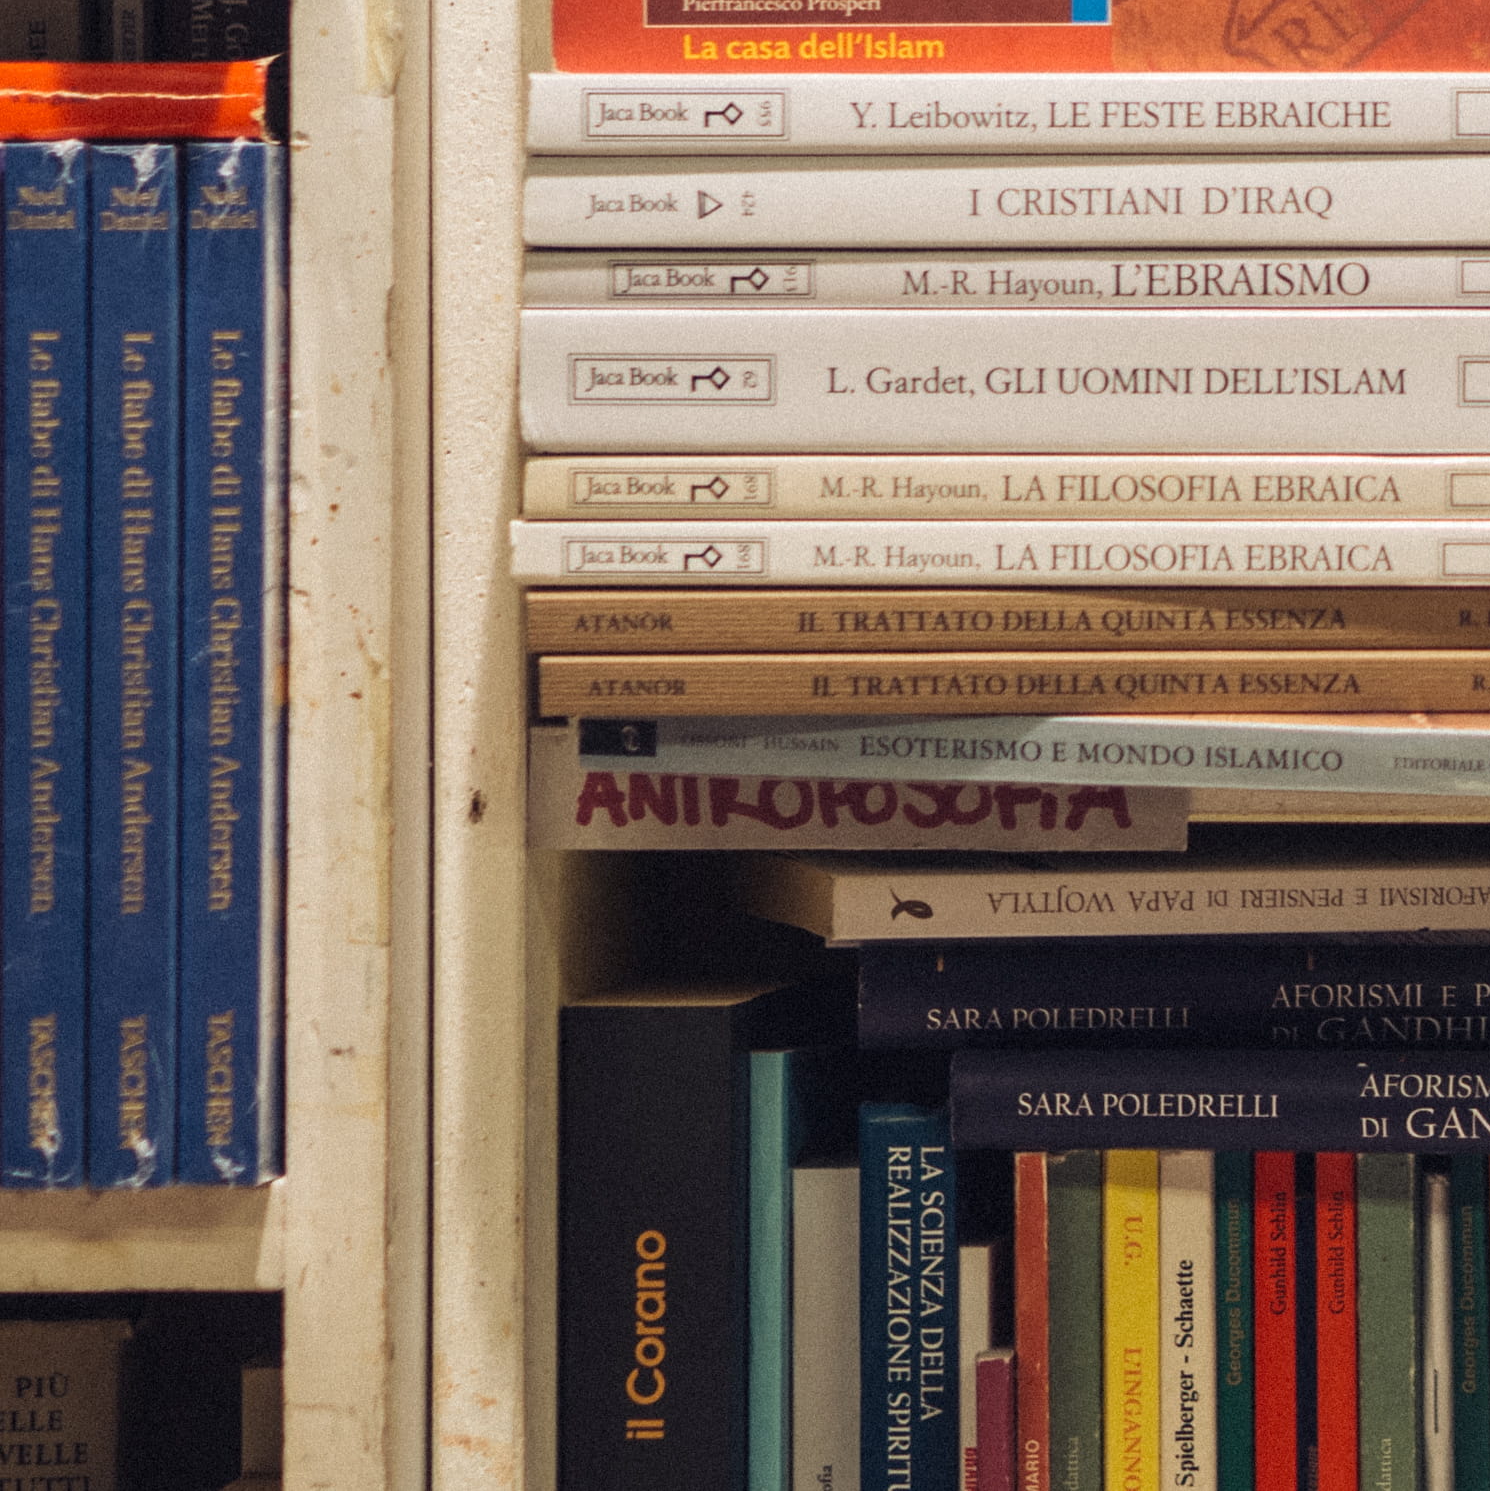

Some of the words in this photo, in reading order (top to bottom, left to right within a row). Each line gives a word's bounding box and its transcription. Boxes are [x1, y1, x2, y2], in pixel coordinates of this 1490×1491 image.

[685, 36, 717, 59] La
[726, 39, 791, 61] casa
[800, 34, 943, 58] dell'Islam
[851, 102, 876, 129] Y.
[889, 101, 1037, 130] Leibowitz,
[1048, 102, 1090, 128] LE
[1102, 102, 1204, 128] FESTE
[1216, 102, 1390, 128] EBRAICHE
[970, 189, 979, 216] I
[997, 188, 1182, 216] CRISTIANI
[1203, 187, 1333, 219] D'IRAQ
[861, 736, 1040, 759] ESOTERISMO
[1052, 742, 1066, 762] E
[1078, 743, 1195, 766] MONDO
[1206, 747, 1343, 771] ISLAMICO
[1018, 1092, 1093, 1116] SARA
[1103, 1093, 1277, 1117] POLEDRELLI
[1362, 1112, 1388, 1137] DI
[921, 1147, 944, 1181] LA
[888, 1147, 911, 1381] REALIZZAZIONE
[920, 1191, 944, 1316] SCIENZA
[626, 1230, 666, 1404] Corano
[920, 1328, 944, 1420] DELLA
[627, 1420, 664, 1439] il
